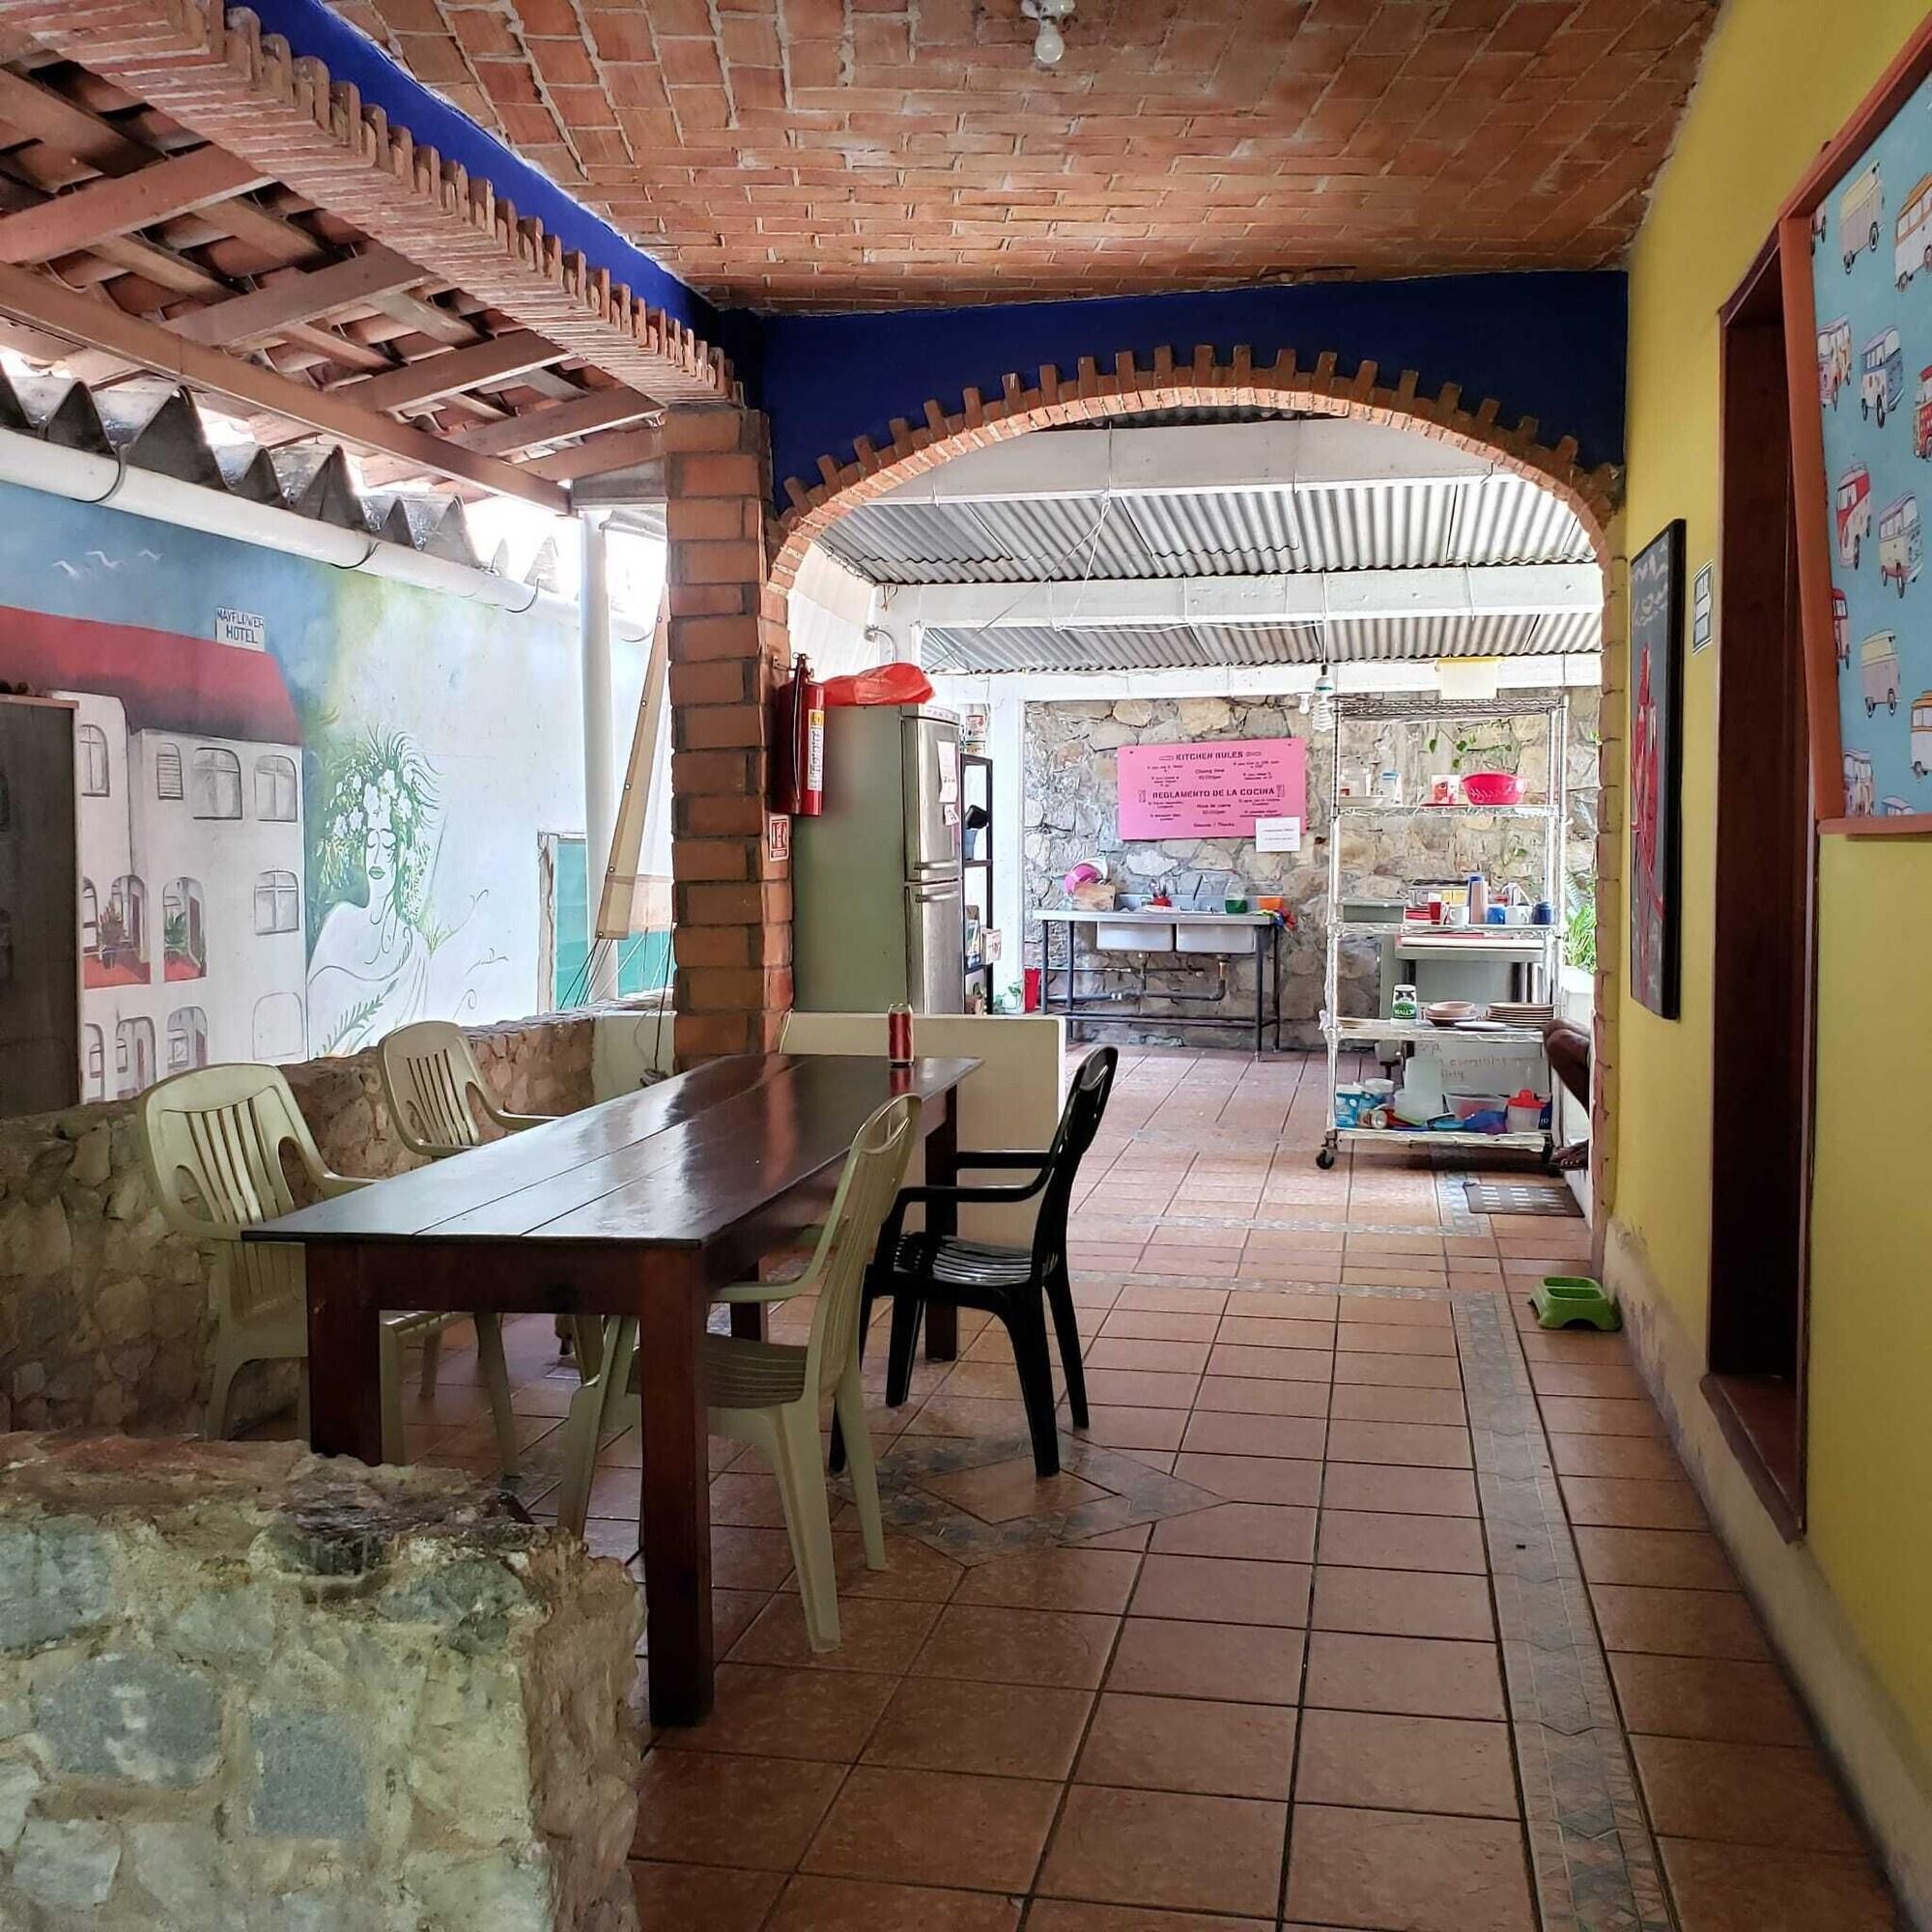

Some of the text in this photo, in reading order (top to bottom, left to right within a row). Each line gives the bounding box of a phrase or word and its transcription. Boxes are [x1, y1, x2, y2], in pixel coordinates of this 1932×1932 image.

[226, 624, 259, 644] HOTEL
[1176, 751, 1243, 761] KITCHEN RULES
[1152, 790, 1210, 799] REGLAMENTO
[1239, 787, 1275, 796] COCINA
